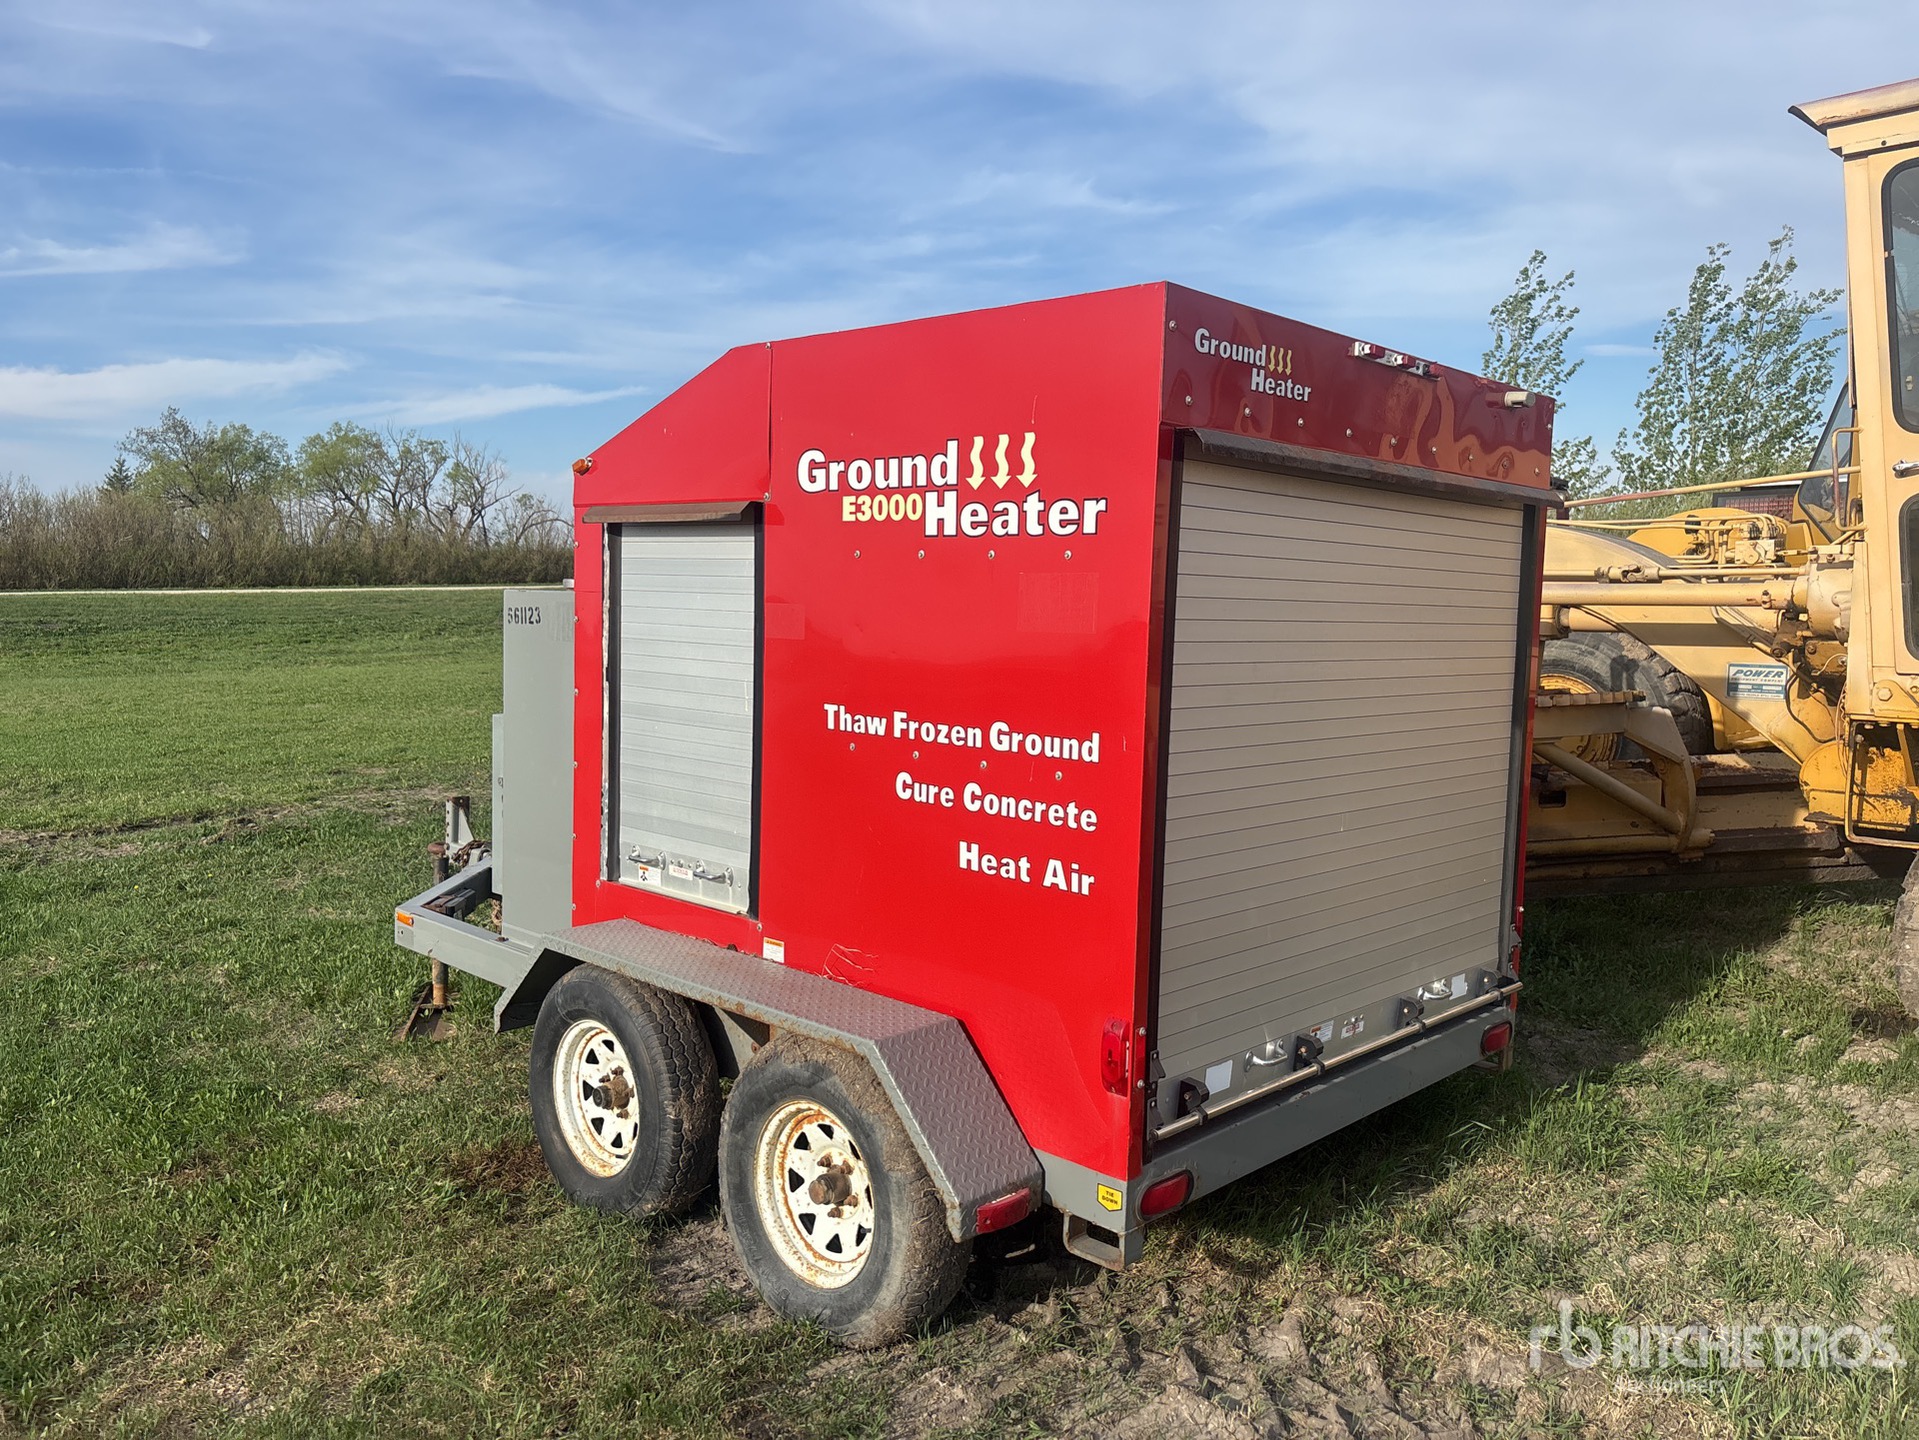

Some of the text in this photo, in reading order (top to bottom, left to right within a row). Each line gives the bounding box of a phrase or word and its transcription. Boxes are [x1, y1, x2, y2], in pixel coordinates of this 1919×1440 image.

[1194, 327, 1267, 367] Ground
[1250, 367, 1312, 402] Heater
[797, 439, 959, 493] Ground
[842, 493, 923, 522] E3000
[924, 490, 1108, 537] Heater
[1732, 669, 1783, 678] POWER
[823, 702, 1100, 764] Thaw Frozen Ground
[894, 771, 1098, 833] Cure Concrete
[958, 840, 1096, 896] Heat Air
[1102, 1195, 1118, 1205] DOWN
[1106, 1190, 1114, 1198] TIE
